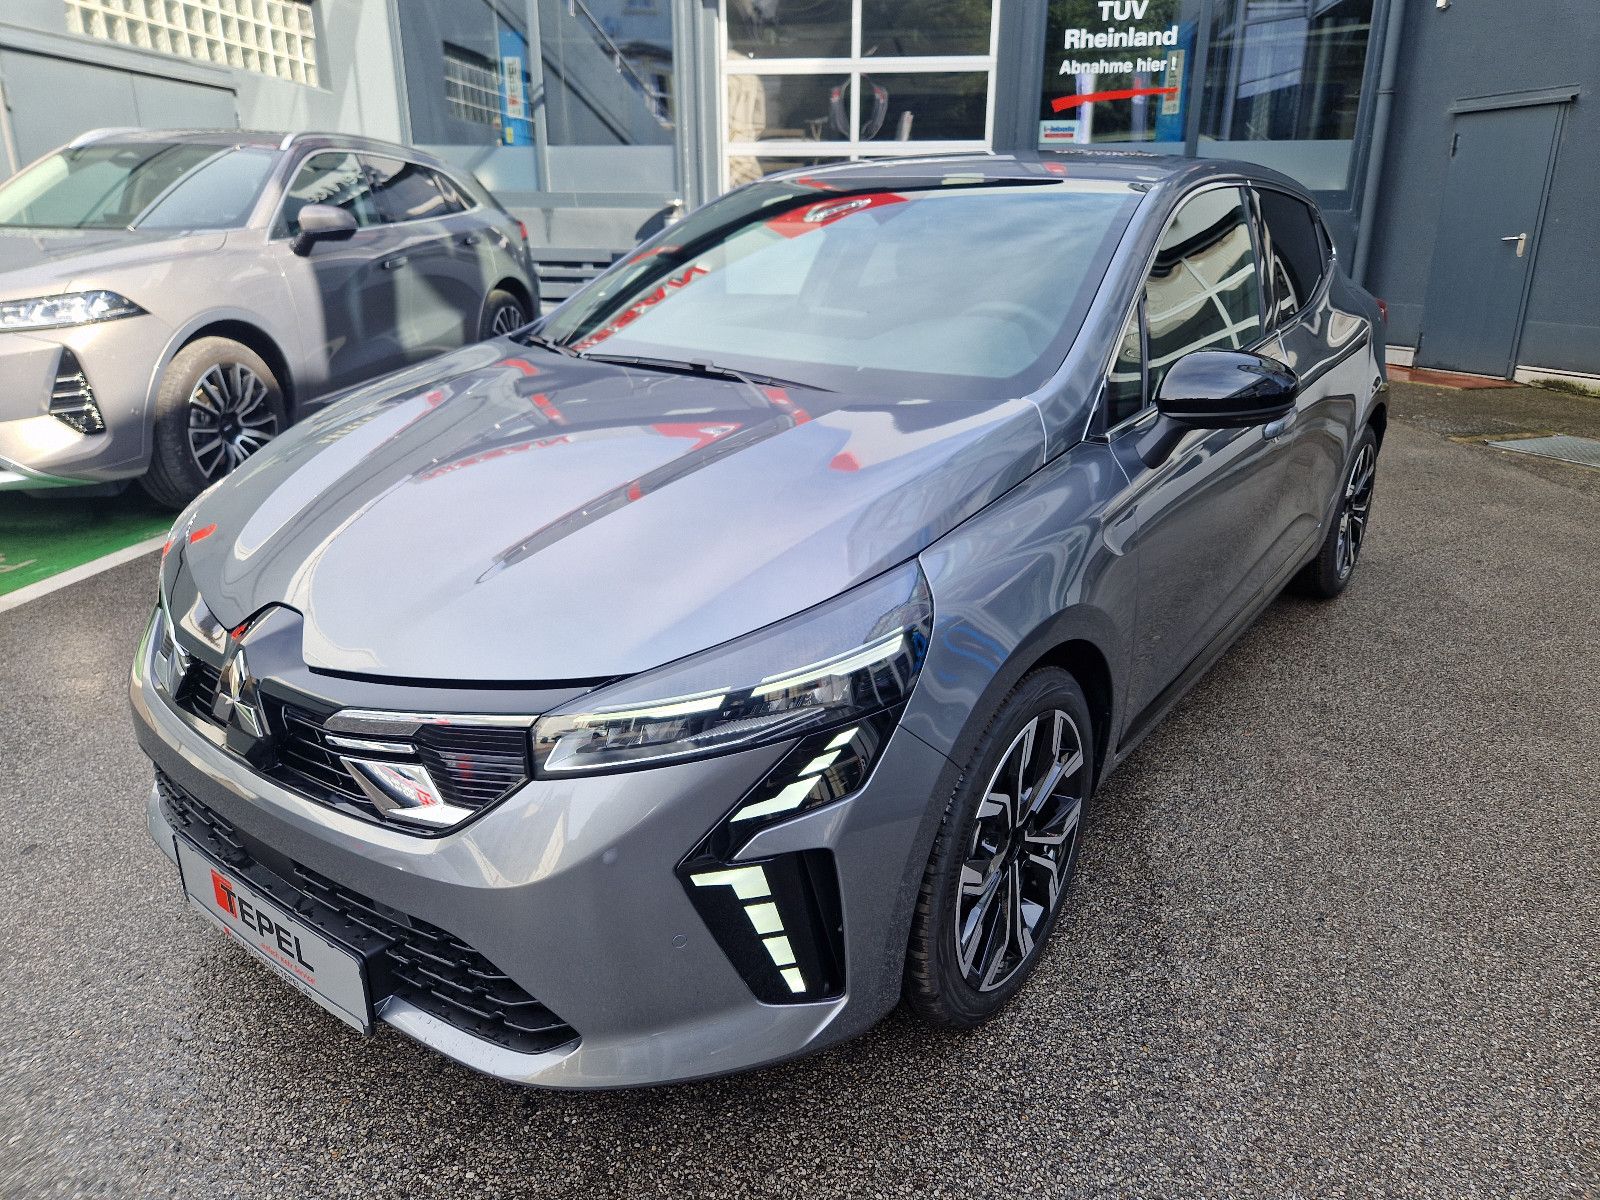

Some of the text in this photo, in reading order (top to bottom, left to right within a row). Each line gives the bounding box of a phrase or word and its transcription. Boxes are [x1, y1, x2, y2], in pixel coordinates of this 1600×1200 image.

[1064, 25, 1179, 49] Rheinland
[1059, 59, 1133, 75] Abnahme
[1136, 57, 1168, 72] hier
[220, 883, 315, 973] TEPEL
